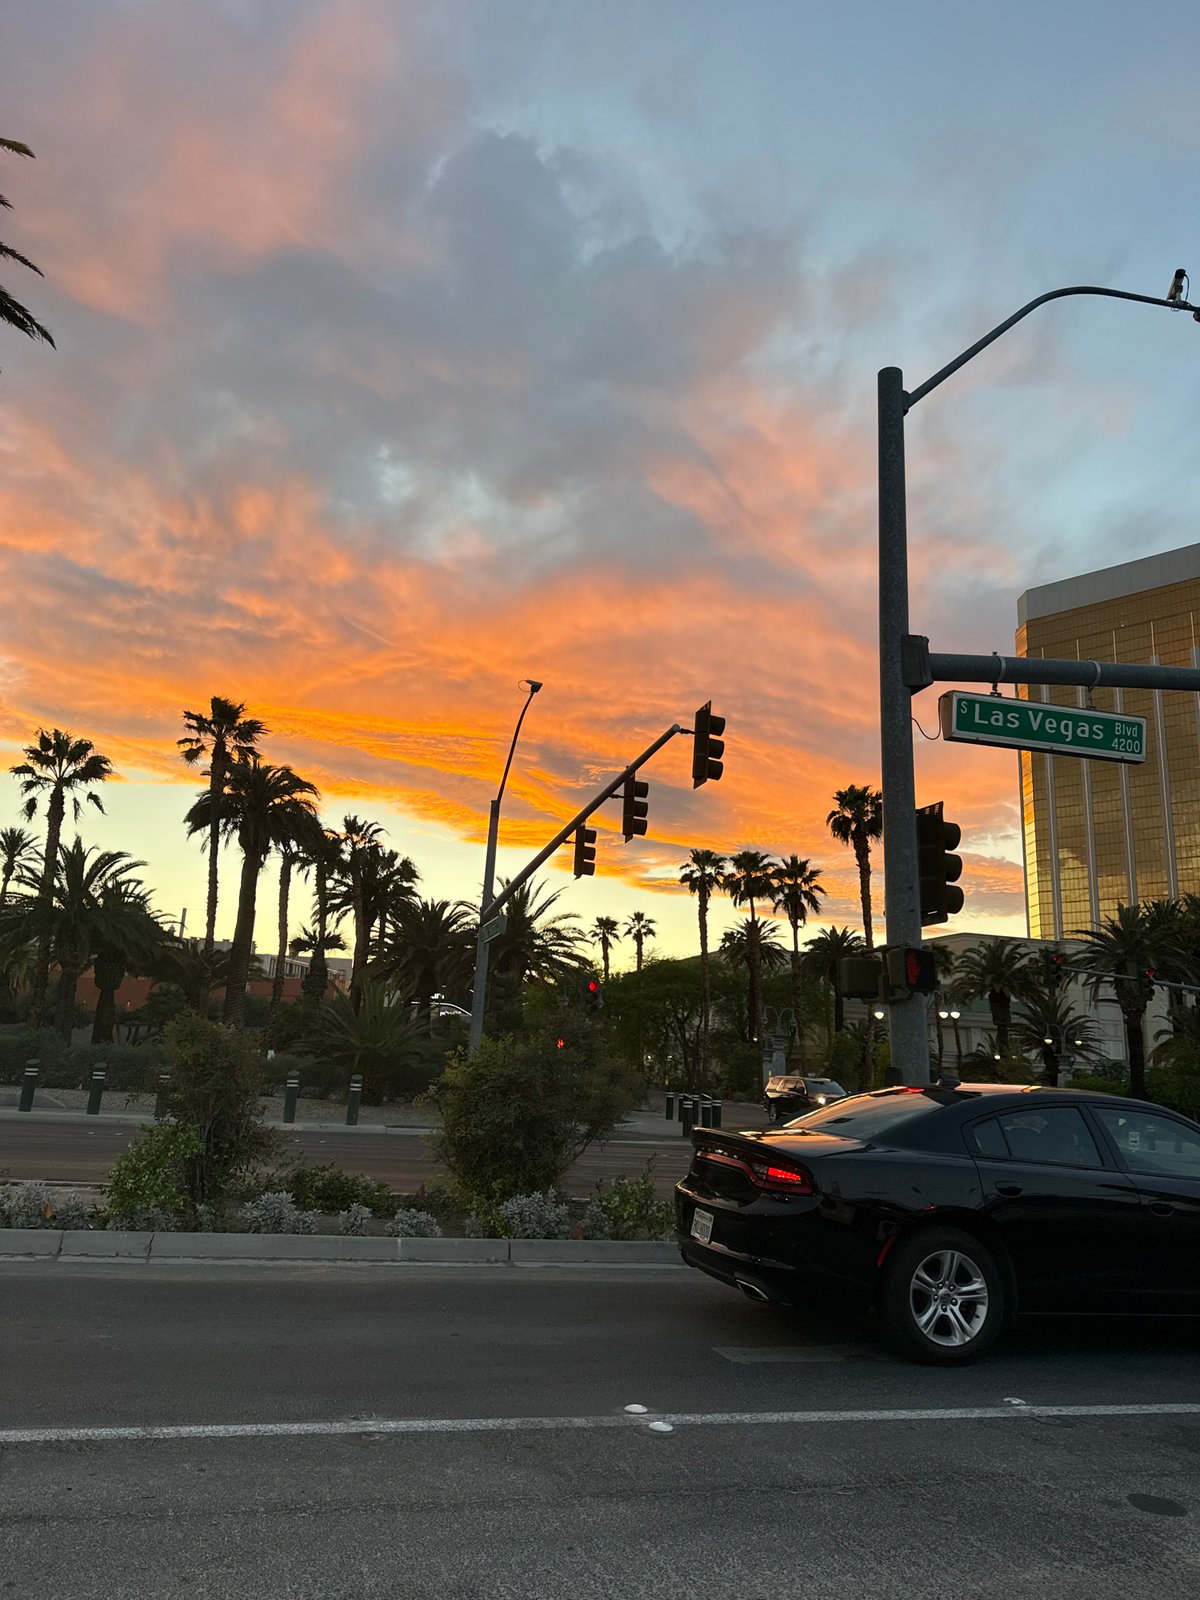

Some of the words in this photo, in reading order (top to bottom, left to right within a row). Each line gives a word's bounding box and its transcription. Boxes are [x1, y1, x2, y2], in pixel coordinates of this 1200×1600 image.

[960, 701, 967, 714] S
[974, 703, 1020, 728] Las
[1028, 710, 1104, 742] Vegas
[1115, 722, 1138, 738] Blvd
[1111, 738, 1141, 753] 4200
